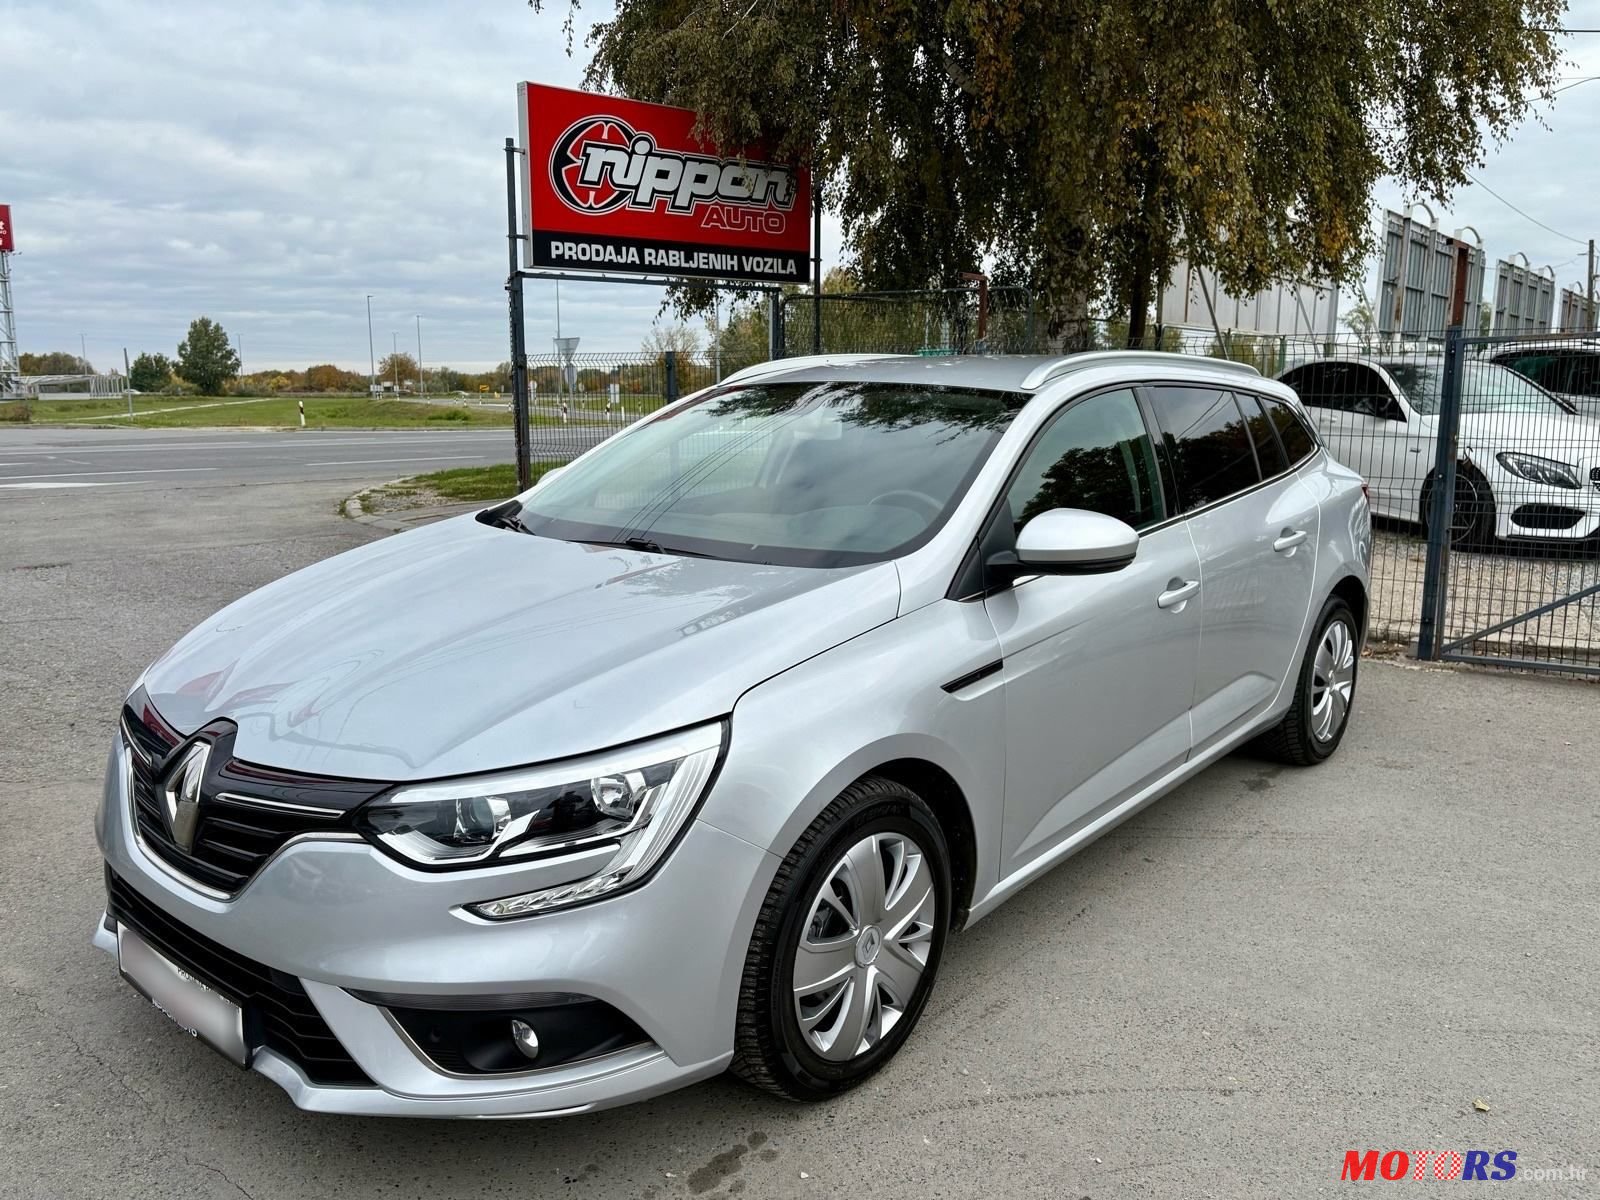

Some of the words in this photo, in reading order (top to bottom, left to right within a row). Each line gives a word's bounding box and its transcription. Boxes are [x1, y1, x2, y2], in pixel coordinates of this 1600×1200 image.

[582, 138, 795, 208] nippon
[702, 206, 786, 234] AUTO
[550, 241, 640, 265] PRODAJA
[644, 247, 738, 272] RABLJENIH
[741, 255, 797, 275] VOZILA
